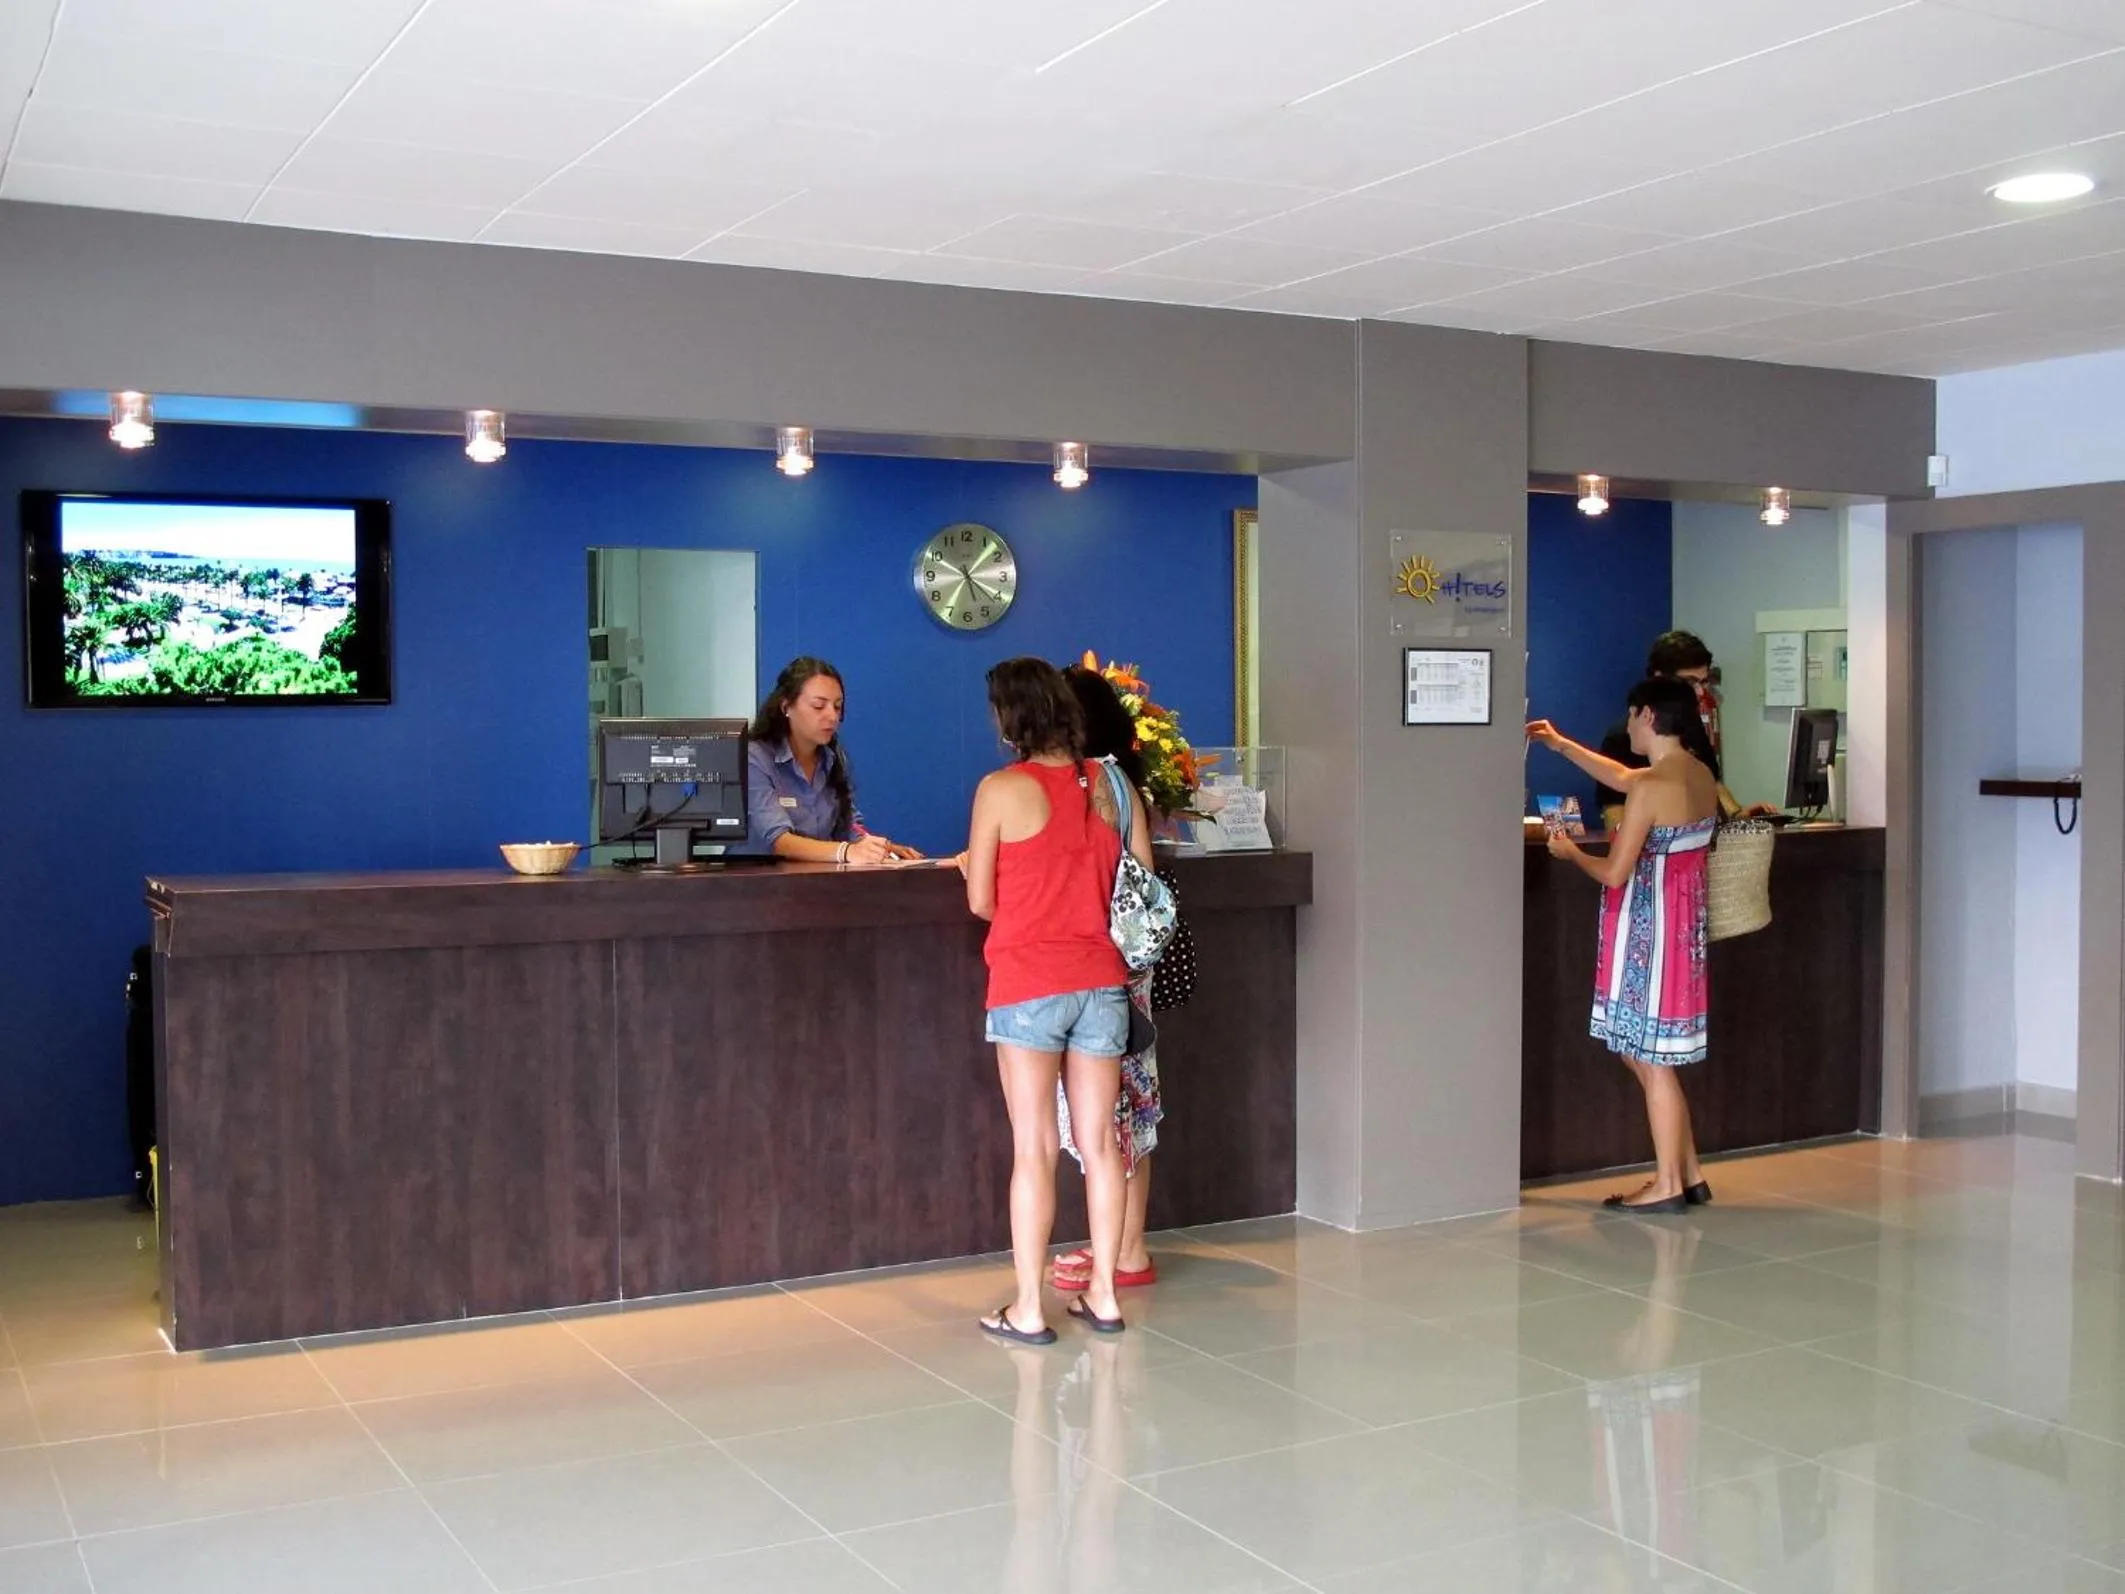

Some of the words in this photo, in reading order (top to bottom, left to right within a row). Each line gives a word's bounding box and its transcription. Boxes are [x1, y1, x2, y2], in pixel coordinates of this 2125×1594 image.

[944, 536, 954, 547] 11
[961, 530, 973, 542] 12
[982, 536, 987, 547] 1
[931, 551, 943, 562] 10
[993, 551, 1002, 562] 2
[926, 571, 935, 582] 9
[999, 571, 1008, 582] 3
[931, 591, 941, 601] 8
[993, 591, 1002, 601] 4
[945, 606, 954, 617] 7
[963, 612, 973, 622] 6
[981, 606, 990, 617] 5
